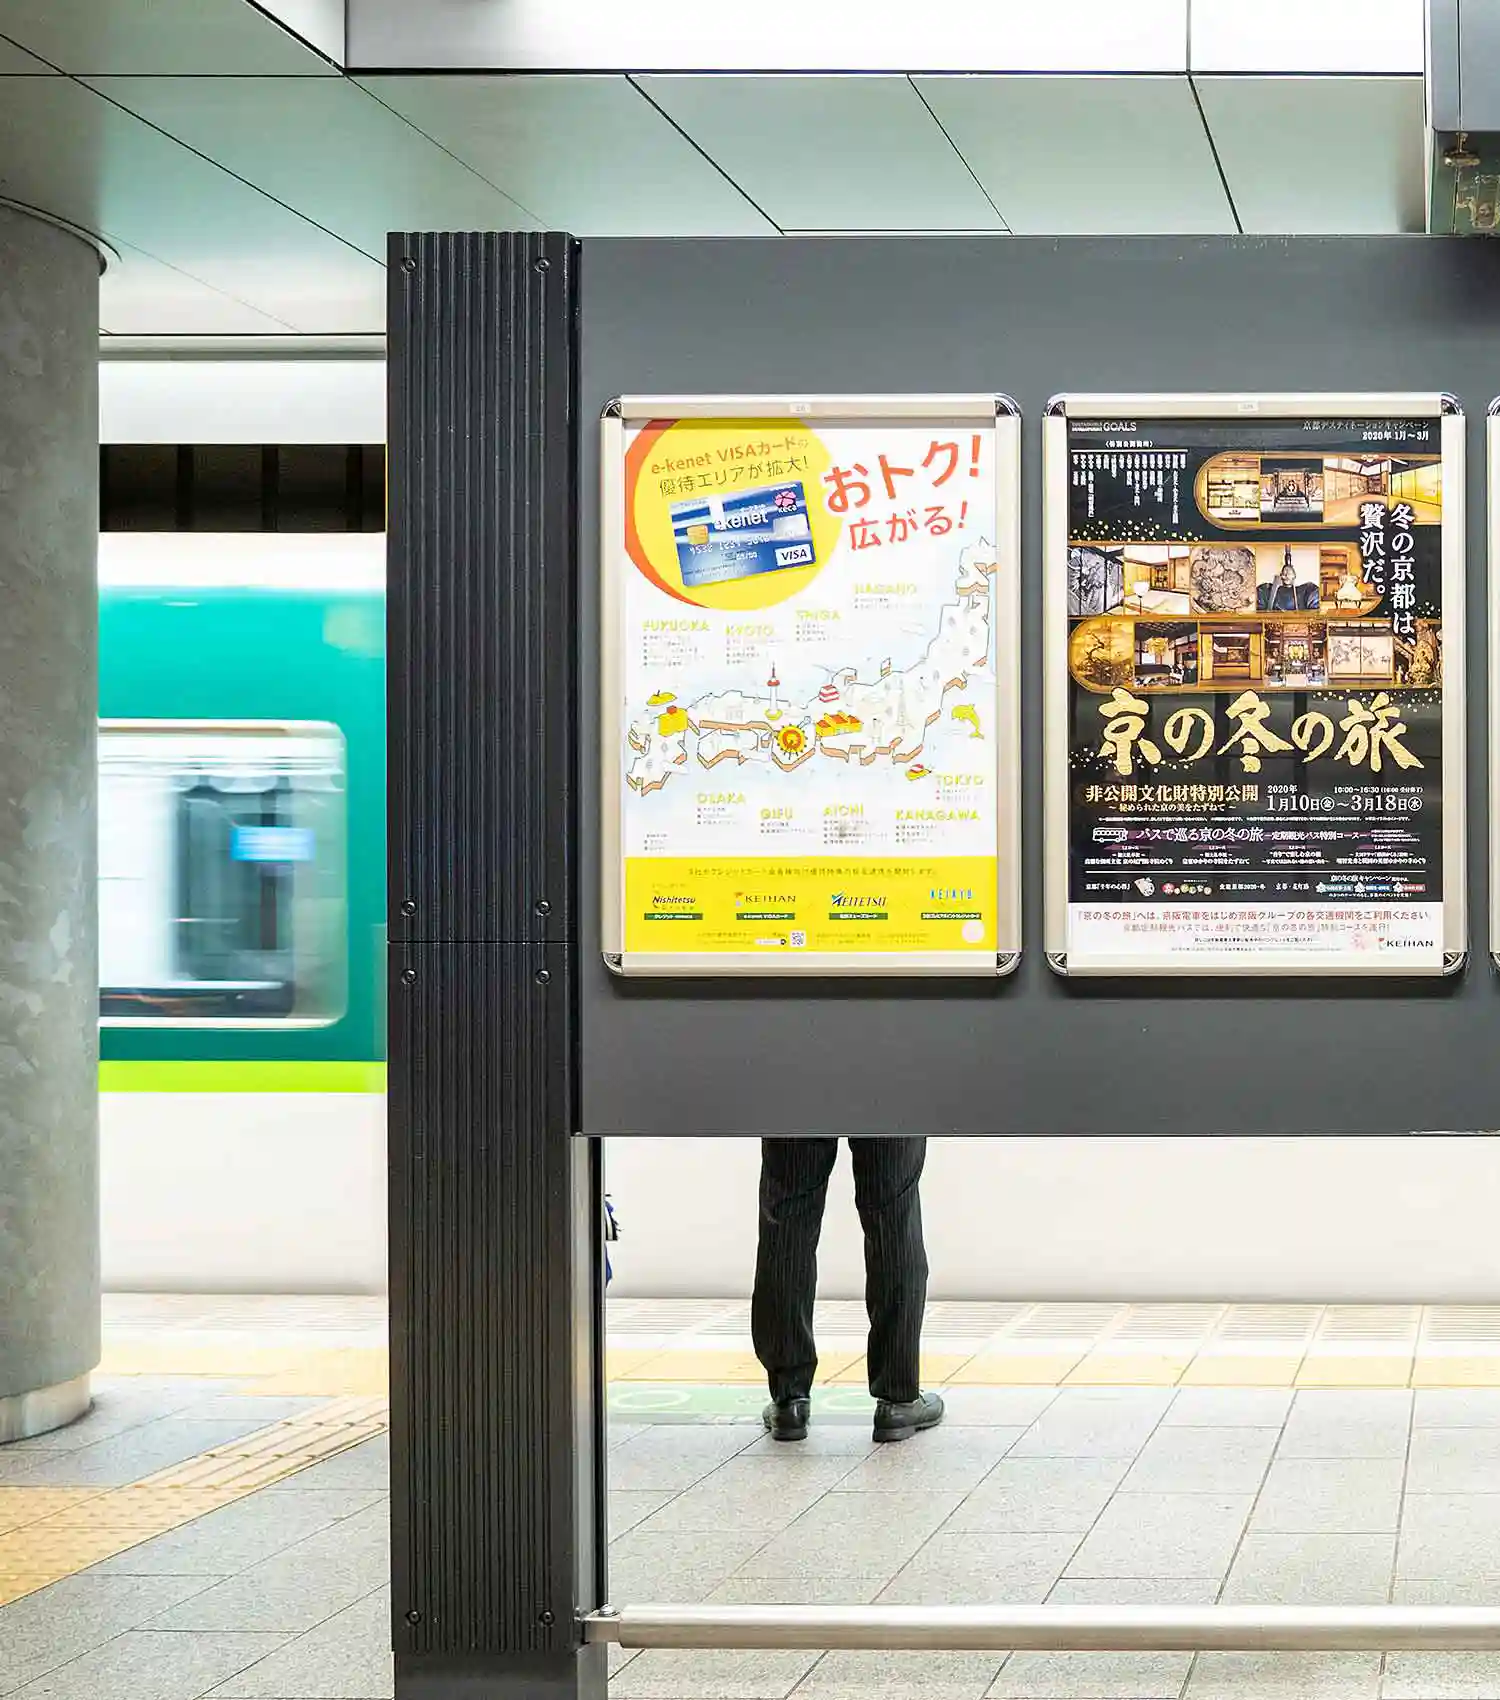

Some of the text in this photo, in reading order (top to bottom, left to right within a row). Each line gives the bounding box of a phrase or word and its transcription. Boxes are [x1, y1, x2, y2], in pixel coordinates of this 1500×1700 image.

[1103, 422, 1137, 432] GOALS
[651, 453, 712, 475] e-kenet
[780, 548, 808, 562] VISA
[1097, 686, 1425, 776] 京の冬の旅
[1085, 784, 1259, 802] 非公開文化財特別公開
[1267, 784, 1298, 794] 2020年
[652, 895, 696, 905] Nishitetsu
[745, 894, 796, 904] KEIHAN
[1386, 939, 1434, 948] KEIHAN
